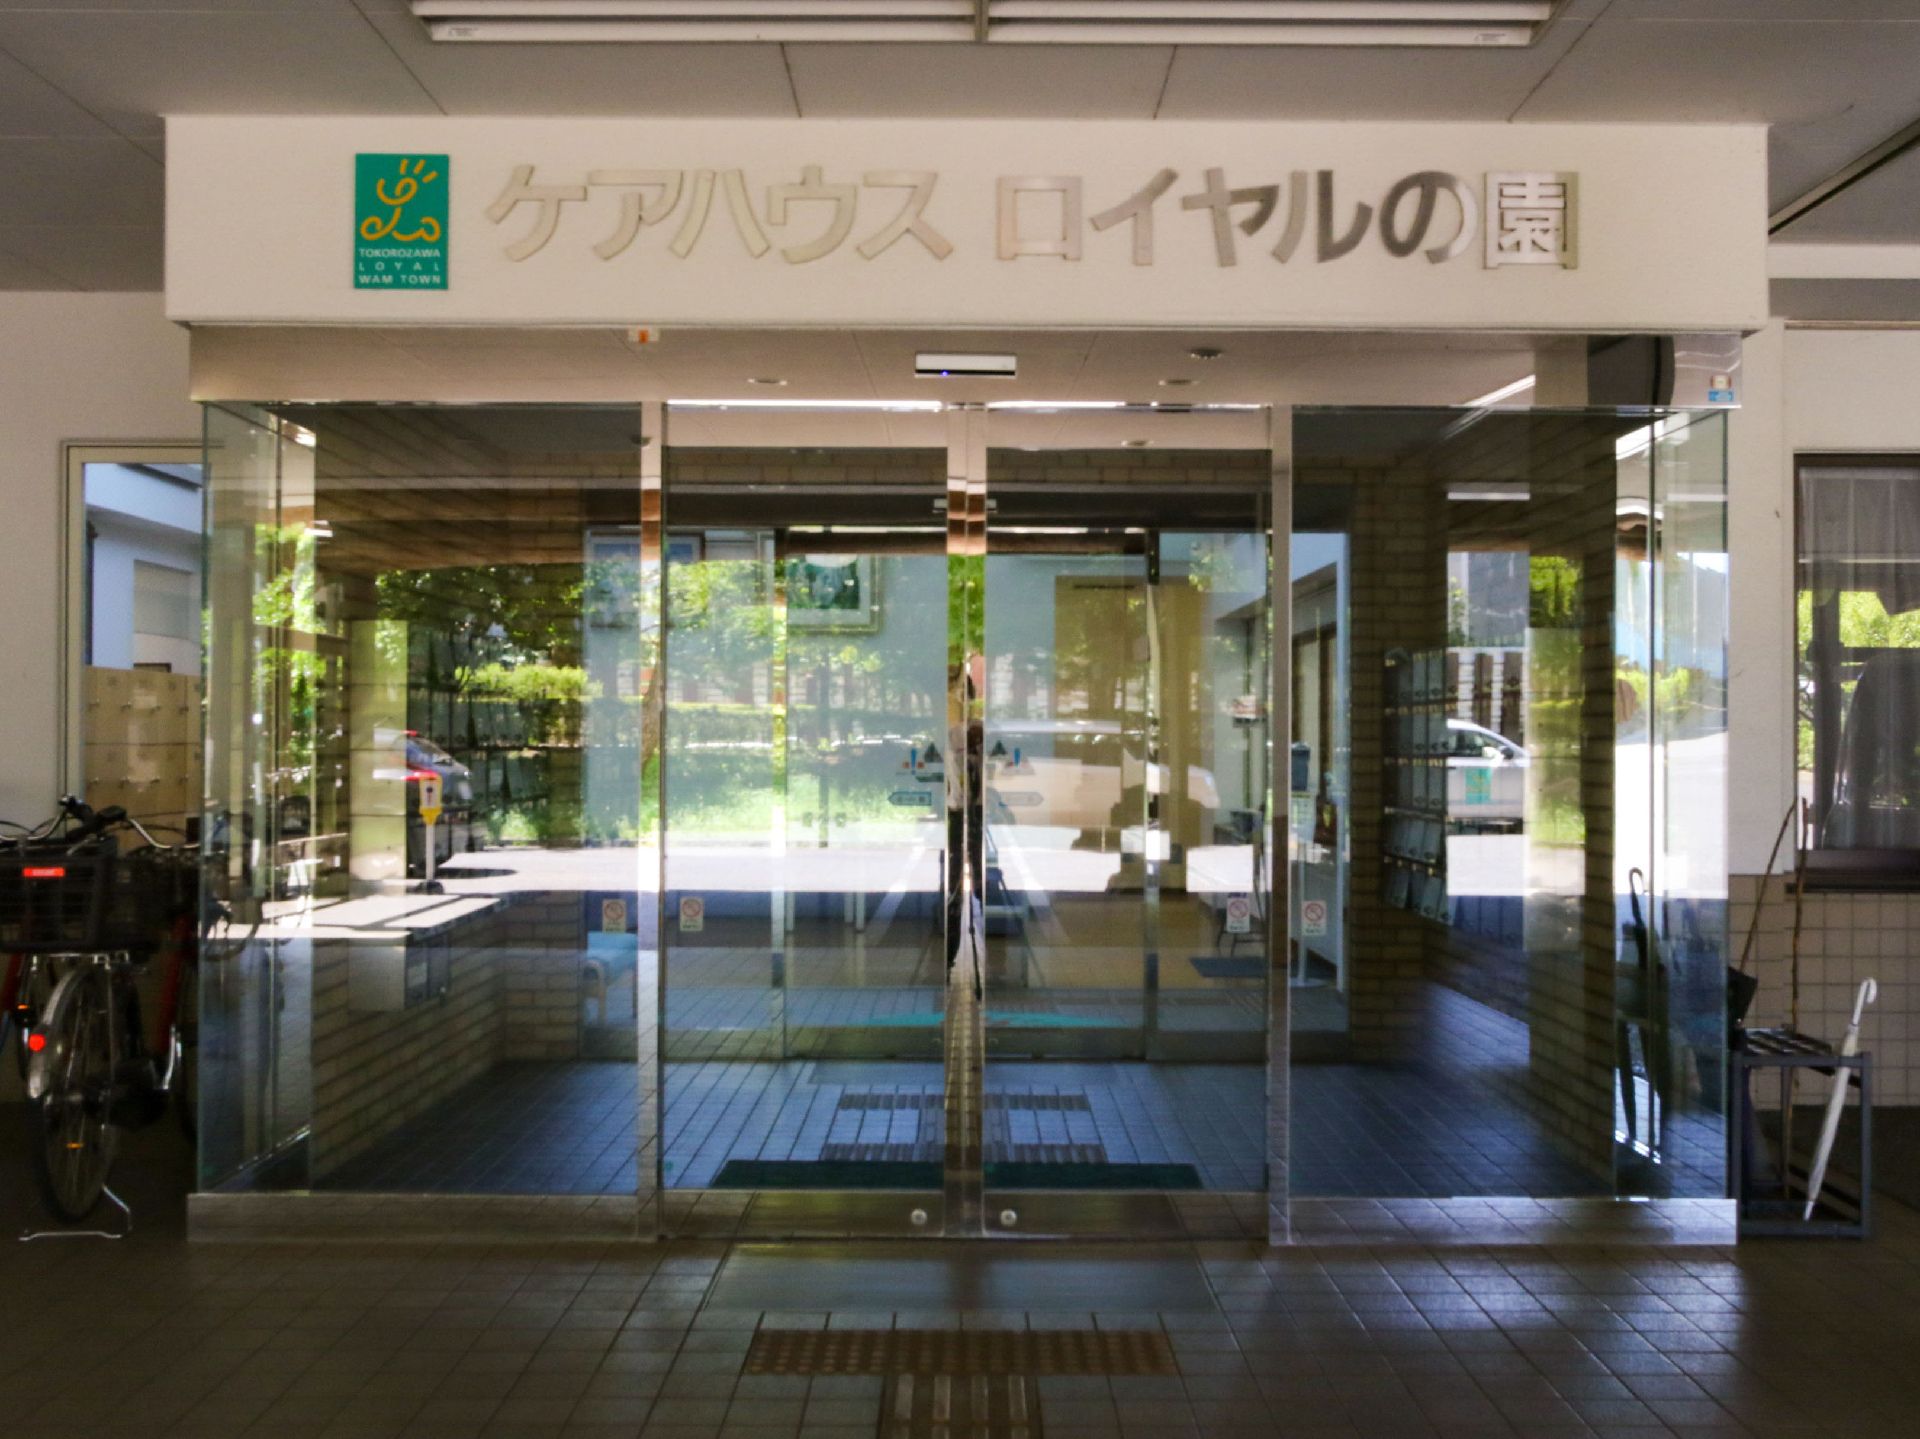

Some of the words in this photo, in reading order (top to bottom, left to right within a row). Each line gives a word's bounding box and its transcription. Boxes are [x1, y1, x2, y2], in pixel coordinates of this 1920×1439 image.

[484, 164, 954, 264] ケアハウス
[995, 167, 1580, 269] ロイヤルの園
[358, 248, 441, 258] TOKOROZAWA
[358, 274, 394, 284] WAM
[400, 274, 441, 284] TOWN
